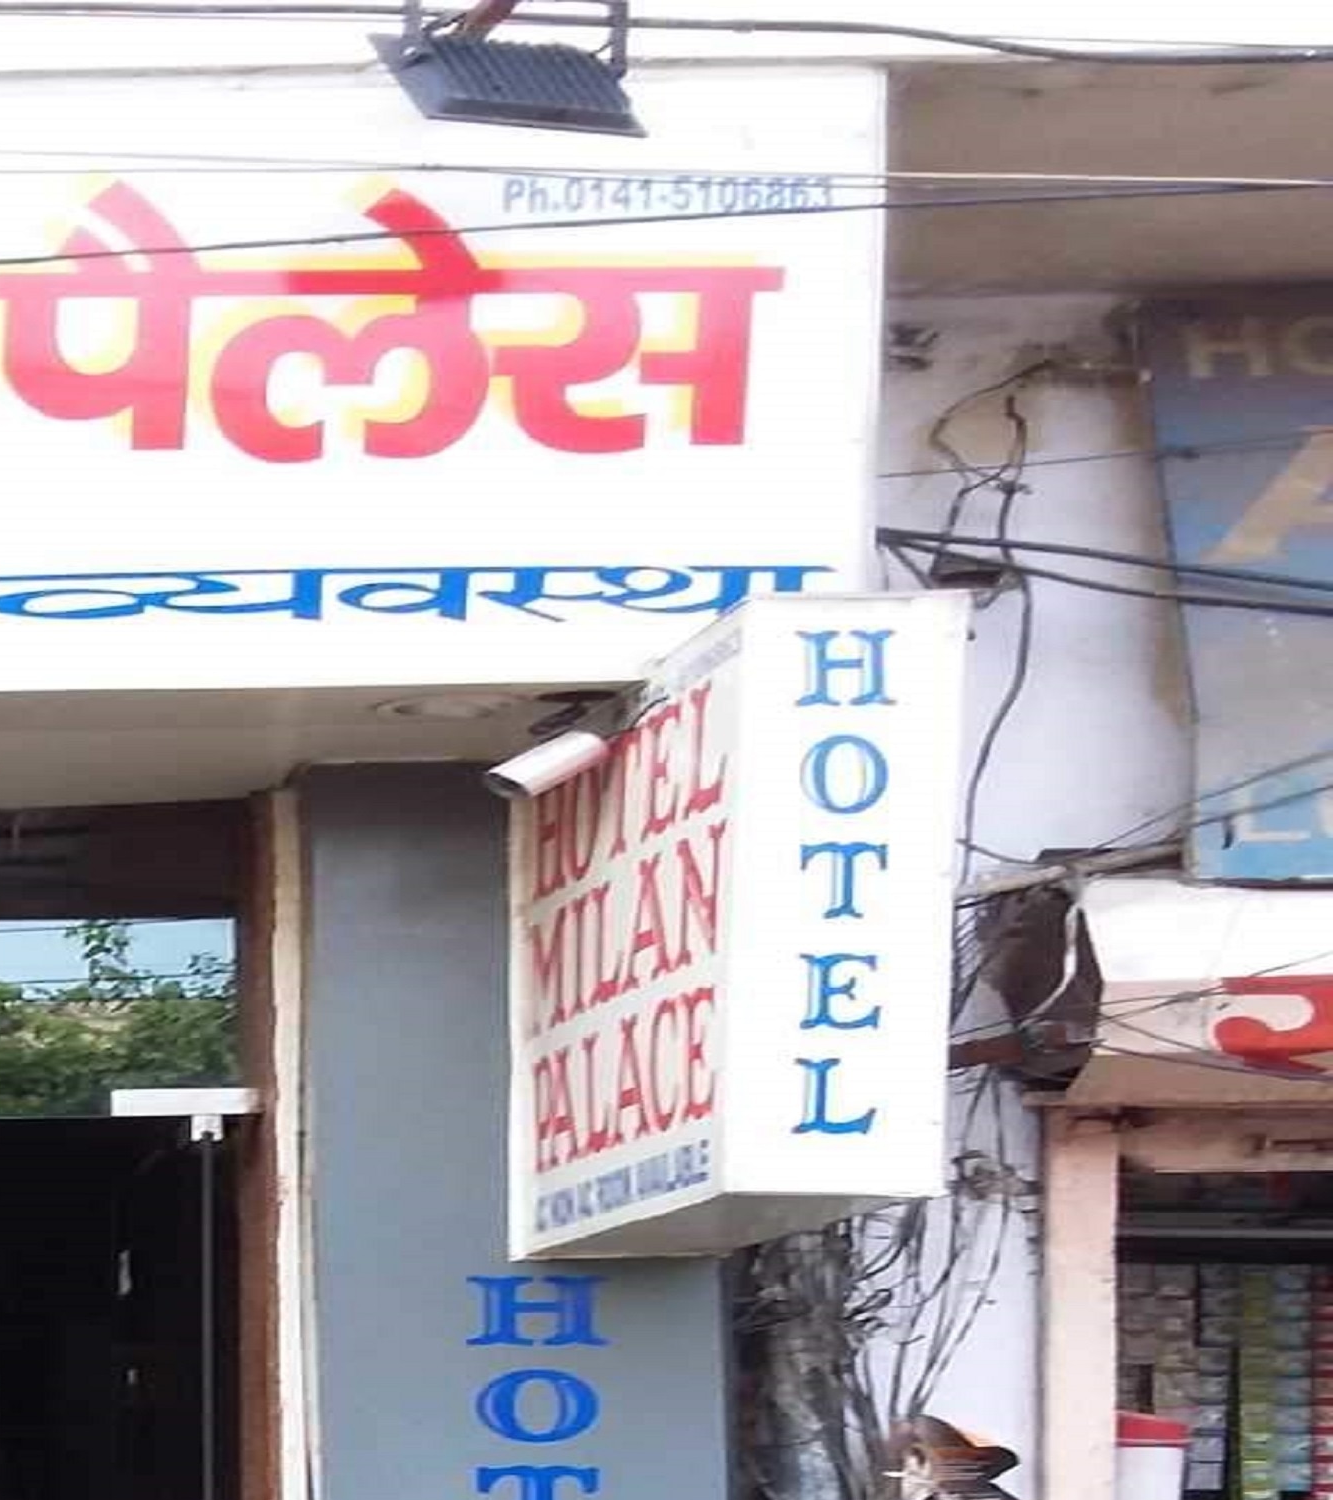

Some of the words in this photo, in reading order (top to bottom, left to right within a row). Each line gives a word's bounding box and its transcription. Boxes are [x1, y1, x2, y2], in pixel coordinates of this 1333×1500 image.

[531, 680, 728, 898] HOTEL
[791, 629, 898, 1136] HOTEL
[530, 818, 726, 1030] MILAN
[533, 986, 716, 1174] PALACE
